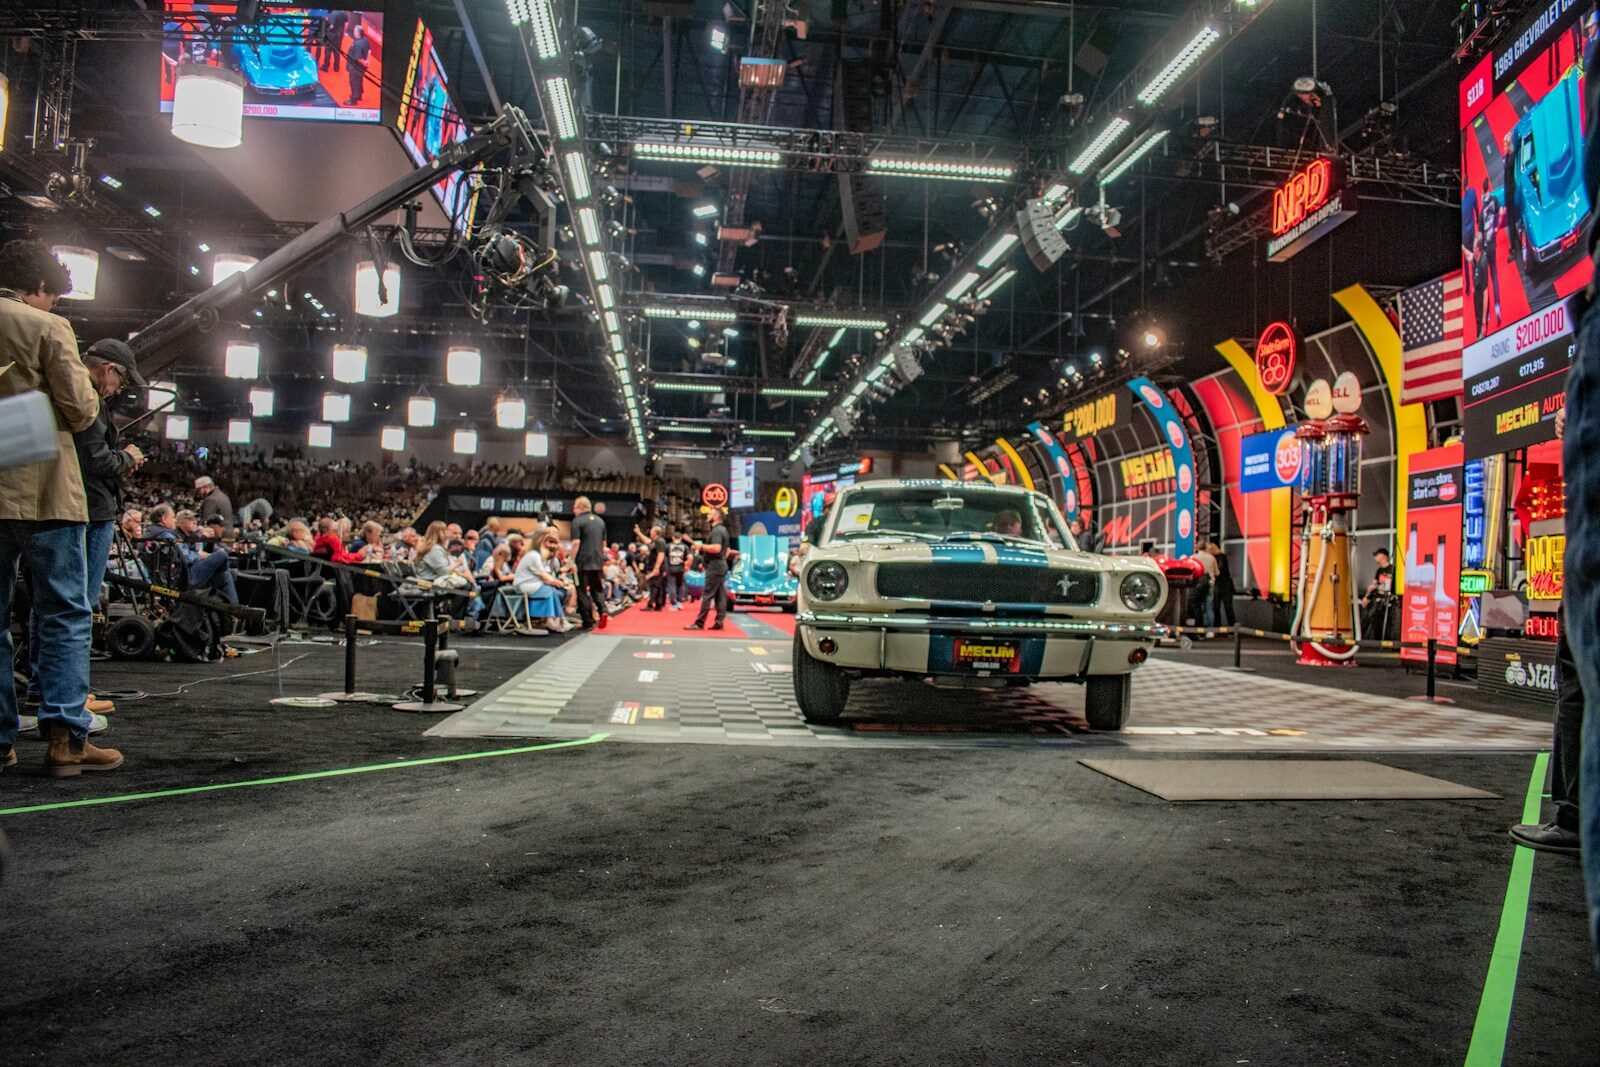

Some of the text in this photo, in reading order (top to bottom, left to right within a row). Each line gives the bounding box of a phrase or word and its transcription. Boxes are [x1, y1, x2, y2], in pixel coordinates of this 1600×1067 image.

[1494, 0, 1562, 80] 1969 CHEVROLET
[1272, 159, 1331, 237] NPD
[1516, 306, 1564, 352] $200,000
[1496, 401, 1539, 435] MECUM
[1119, 450, 1176, 487] MECUM
[1277, 446, 1299, 469] 303
[150, 584, 180, 598] MECUM
[960, 645, 1015, 658] MECUM
